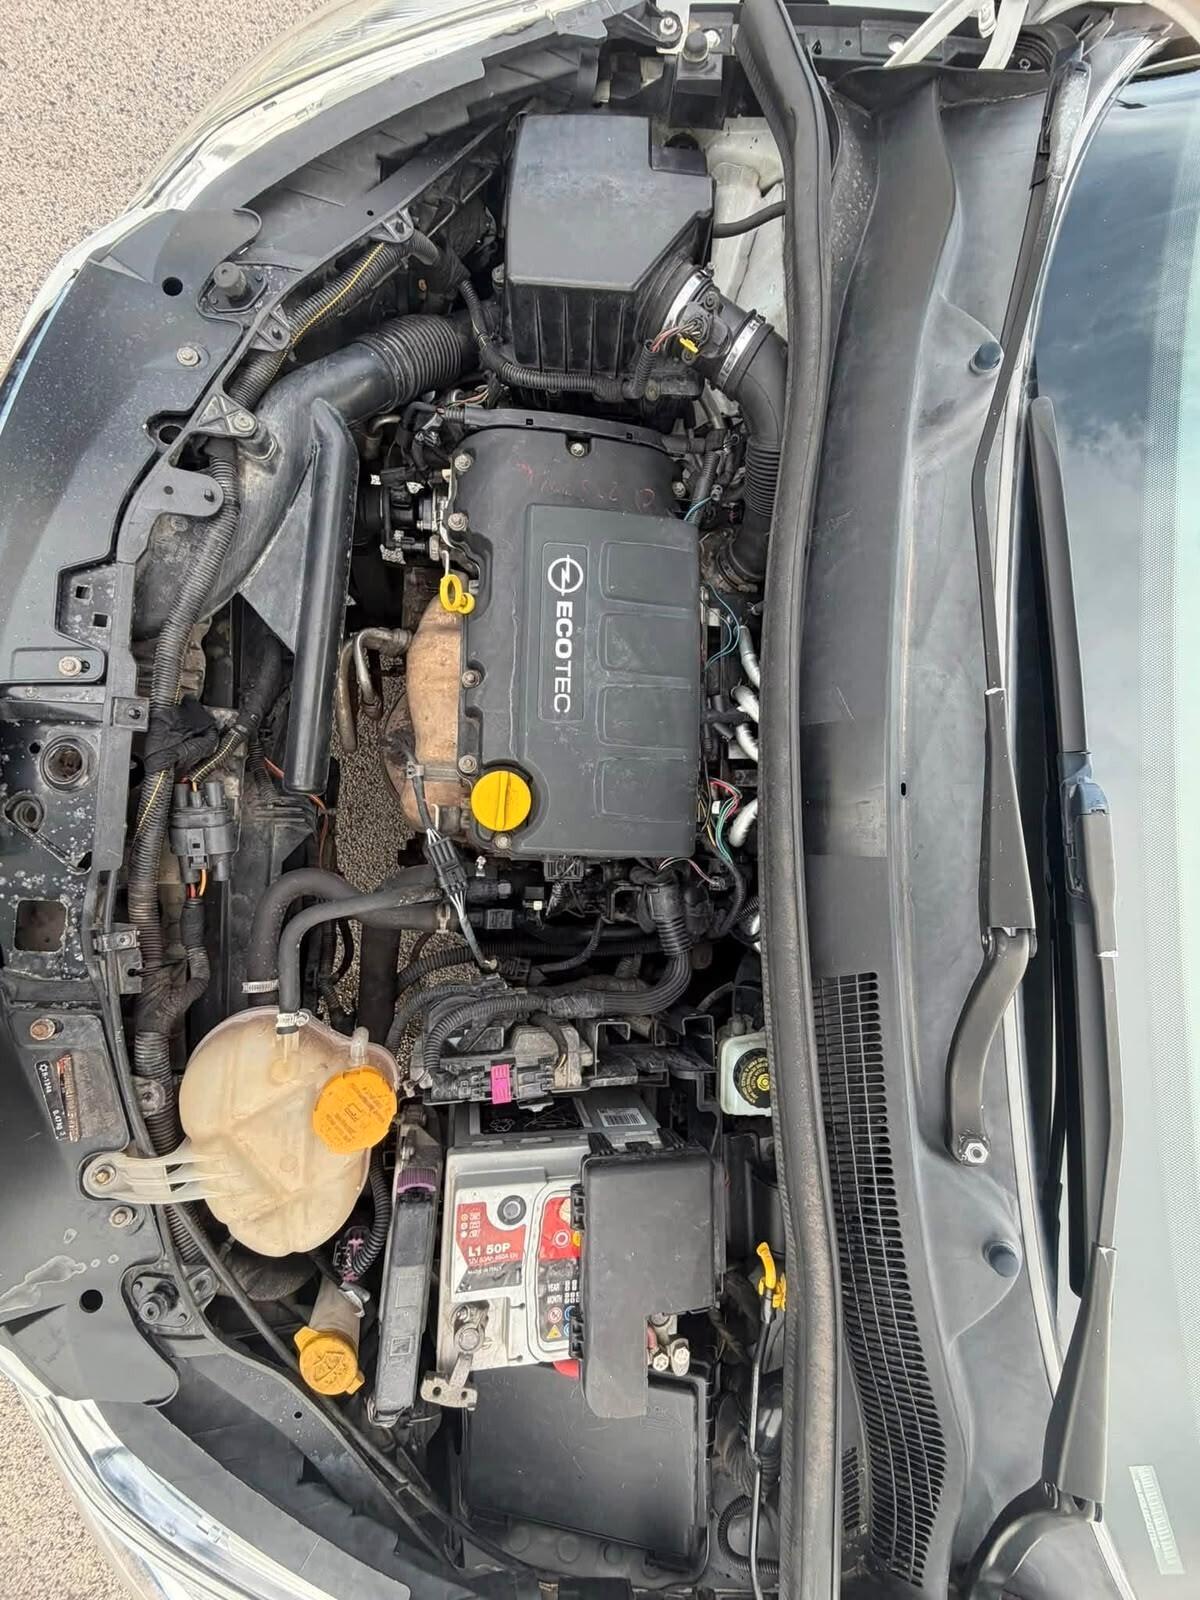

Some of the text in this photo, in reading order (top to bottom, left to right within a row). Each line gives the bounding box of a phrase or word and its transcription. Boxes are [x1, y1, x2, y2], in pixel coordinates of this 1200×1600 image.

[554, 601, 573, 713] ECOTEC
[468, 1242, 511, 1257] L1 50P
